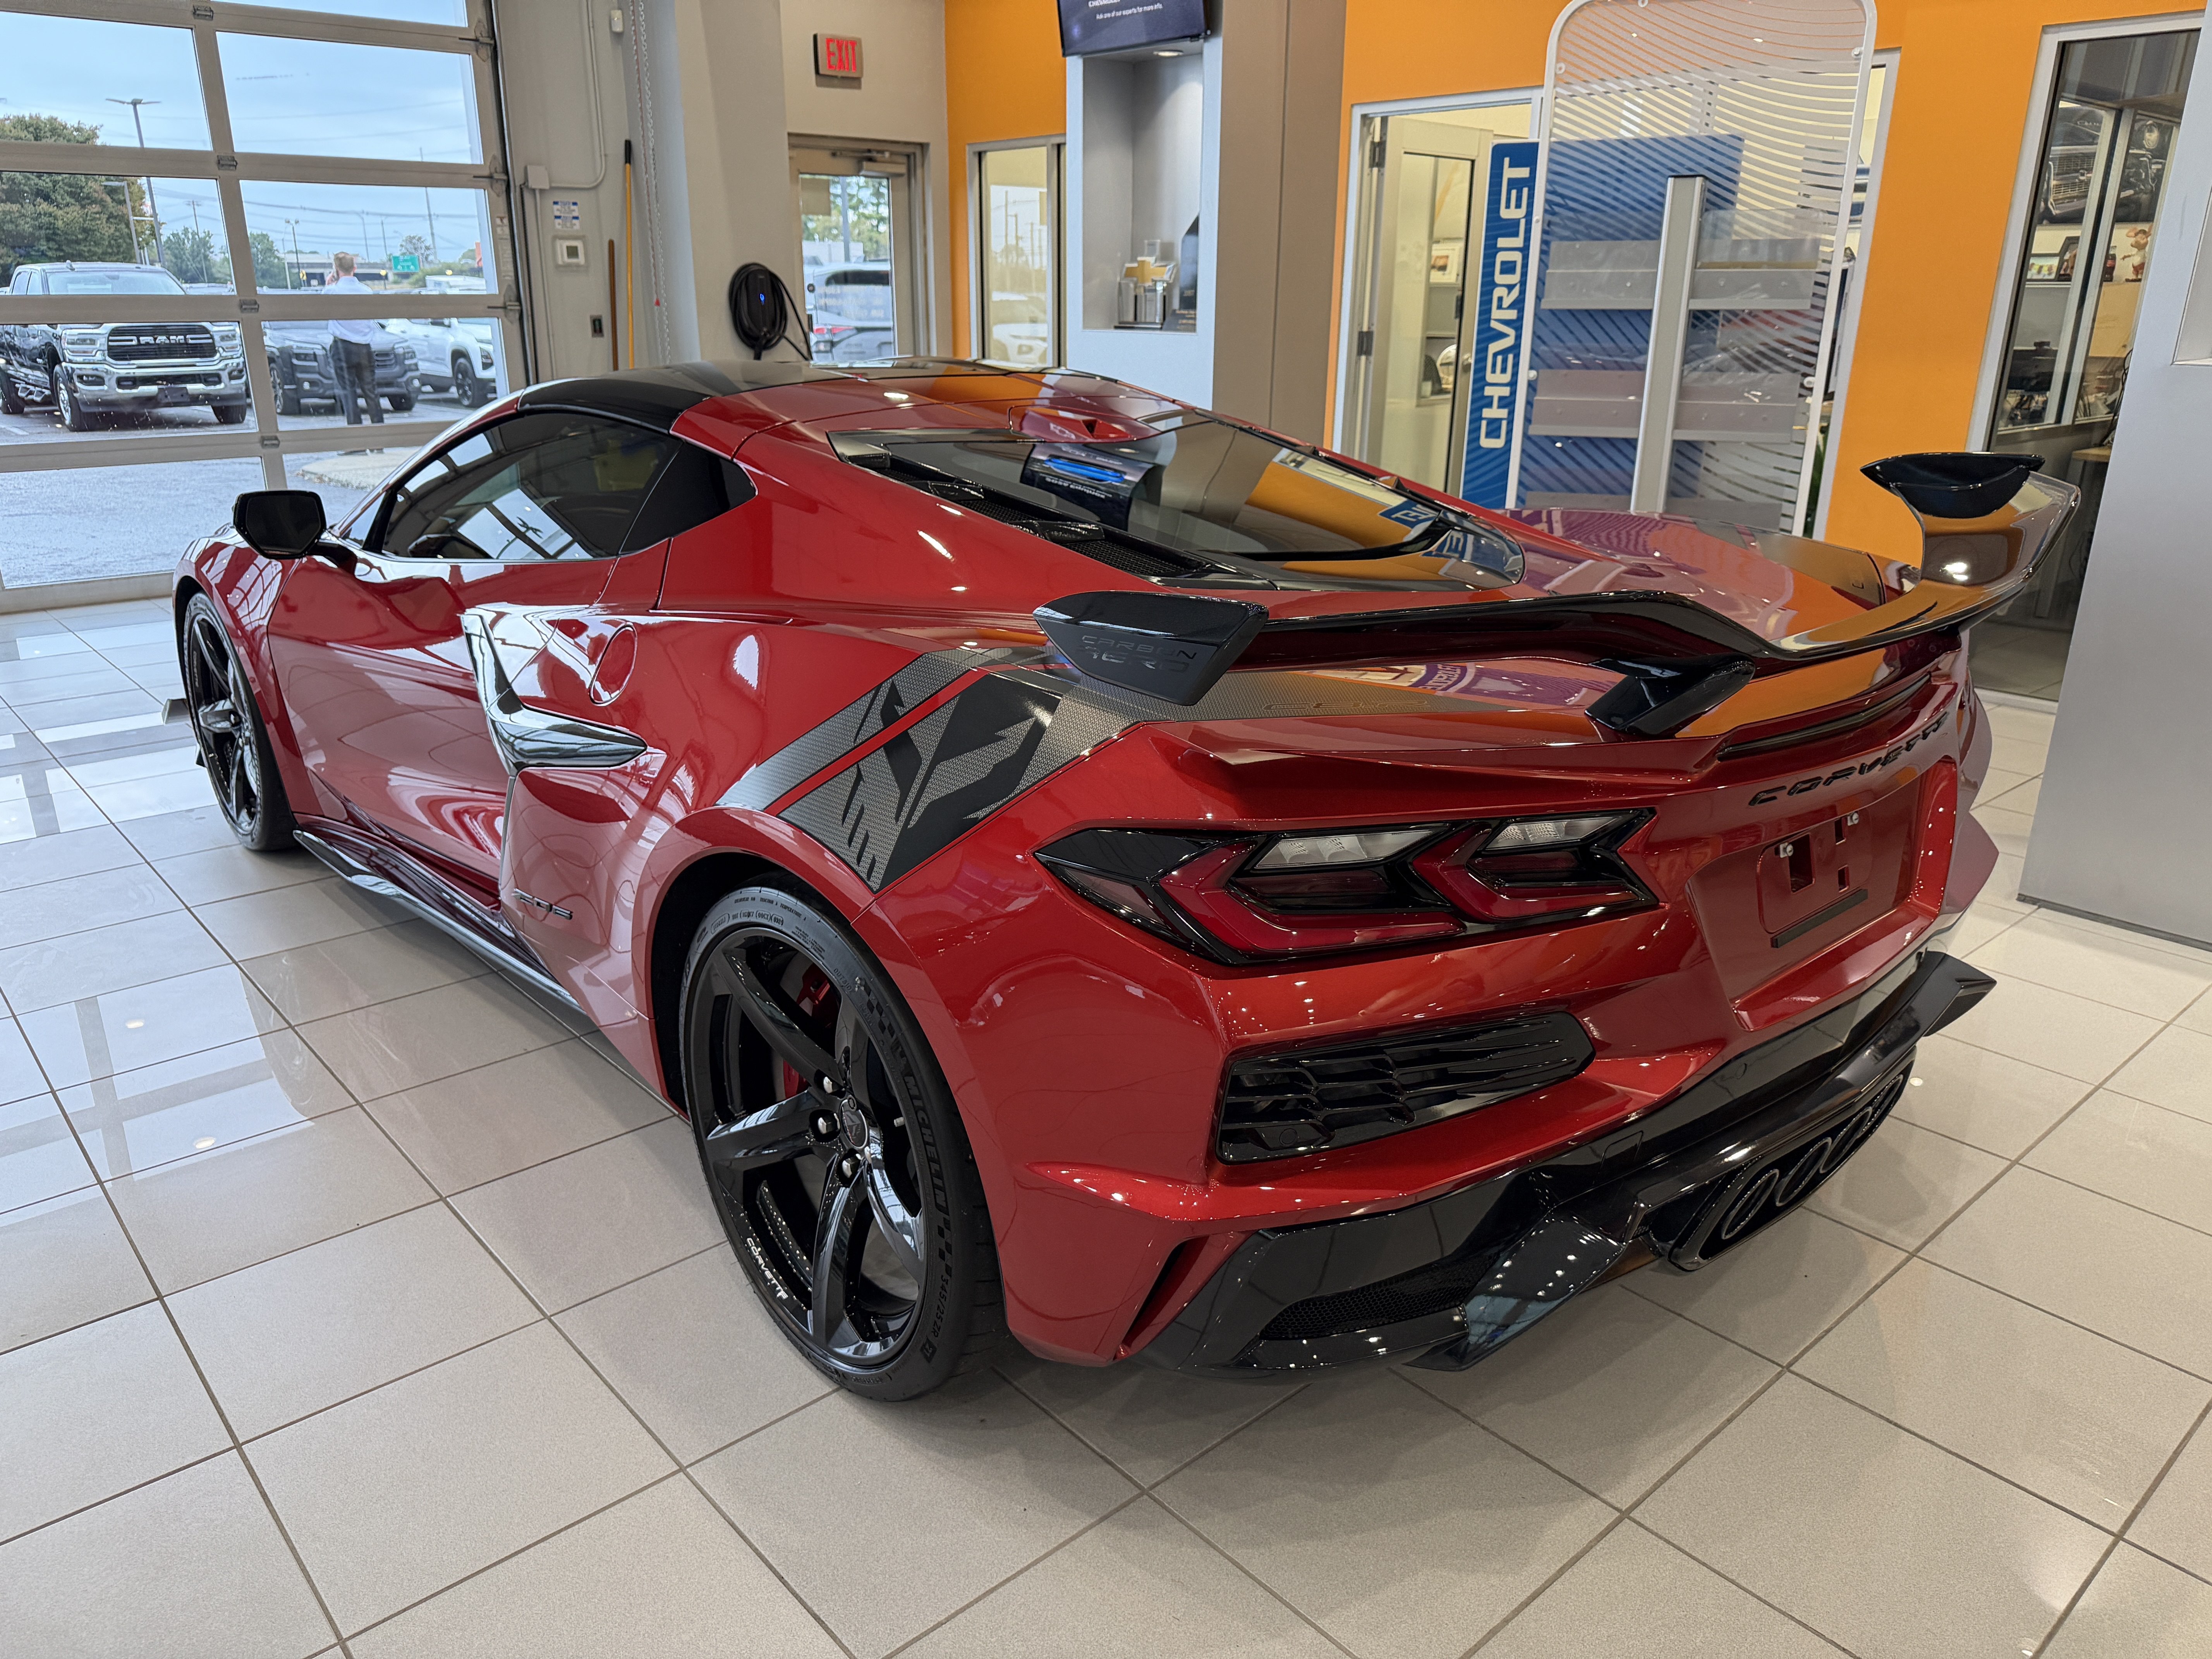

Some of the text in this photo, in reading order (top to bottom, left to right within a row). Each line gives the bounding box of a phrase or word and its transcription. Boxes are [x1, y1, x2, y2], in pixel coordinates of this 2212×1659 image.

[825, 37, 857, 73] EXIT
[1479, 157, 1531, 449] CHEVROLET
[139, 335, 185, 344] RAM
[1079, 646, 1189, 673] AERO
[1082, 635, 1197, 659] CARBON
[1748, 711, 1949, 806] CORVETTE
[904, 1076, 946, 1207] MICHELIN
[747, 1237, 789, 1300] CORVETTE
